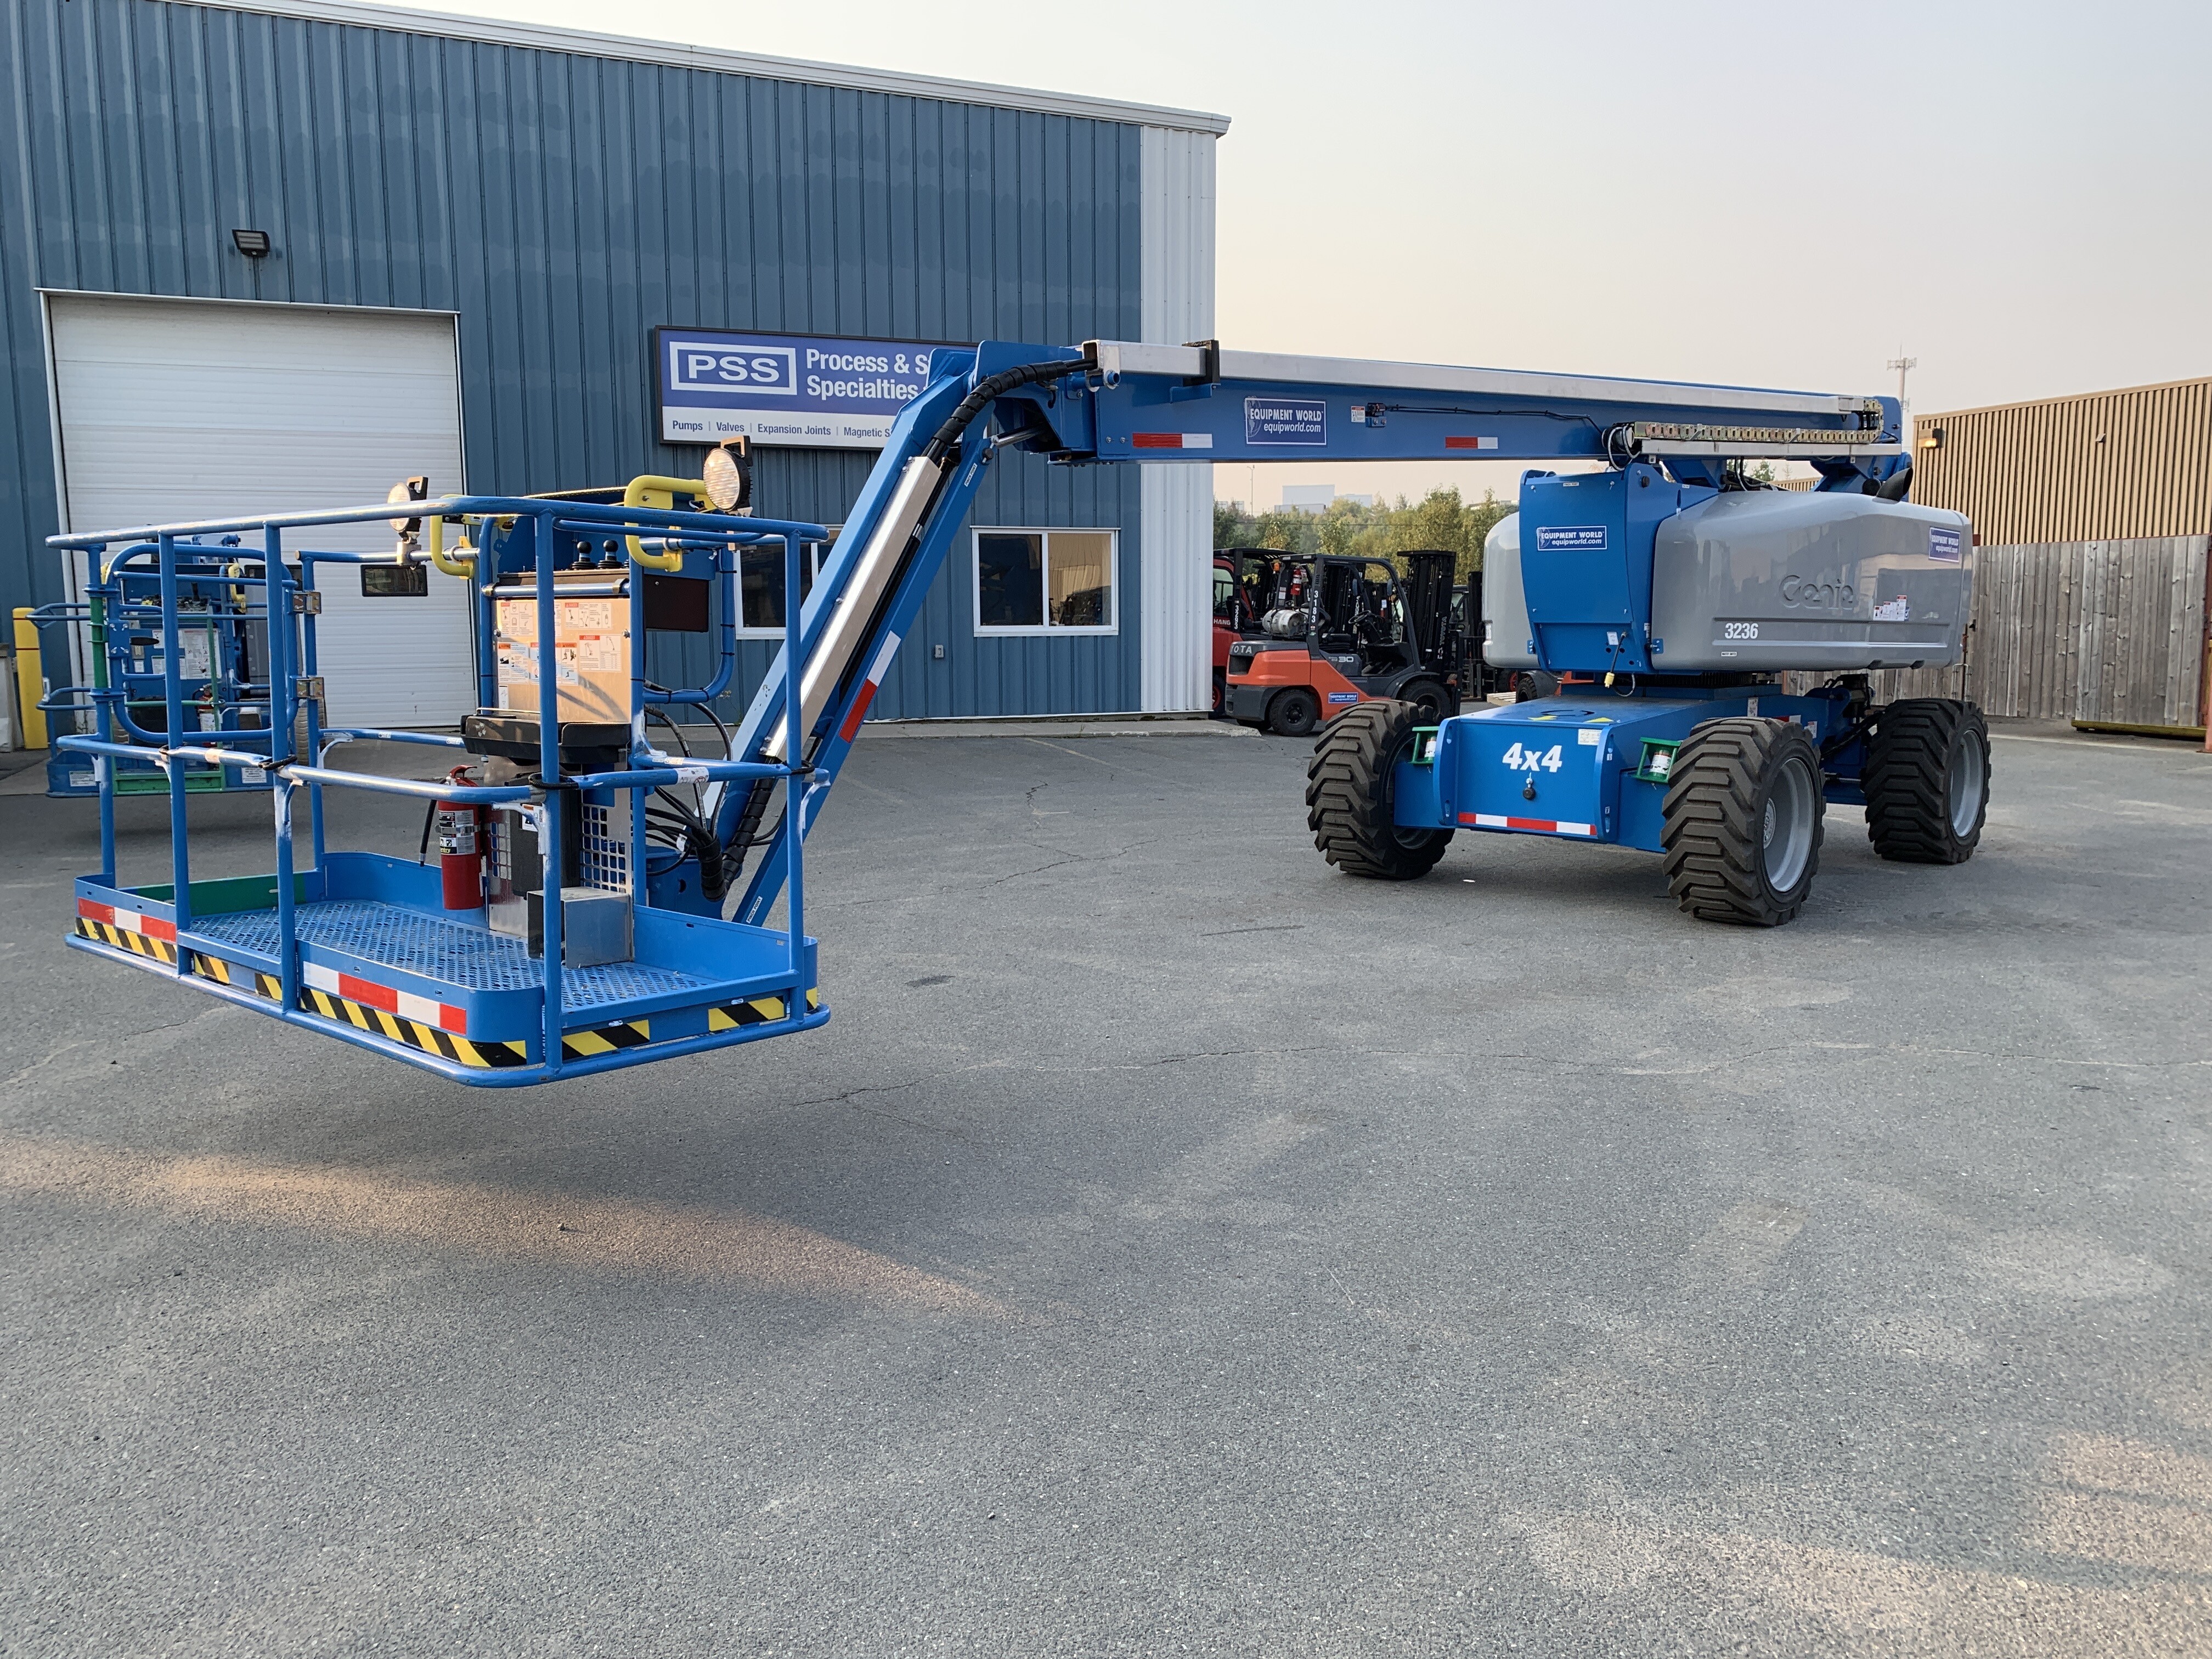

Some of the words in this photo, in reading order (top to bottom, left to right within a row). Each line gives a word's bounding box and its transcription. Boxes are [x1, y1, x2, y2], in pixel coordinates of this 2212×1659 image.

[687, 354, 780, 382] PSS
[806, 348, 888, 373] Process
[894, 353, 910, 374] &
[915, 354, 930, 375] S
[807, 375, 918, 400] Specialties
[1250, 408, 1293, 421] EQUIPMENT
[1296, 410, 1322, 421] WORLD
[672, 420, 703, 432] Pumps
[716, 422, 744, 432] Valves
[758, 424, 802, 436] Expansion
[805, 425, 831, 436] Joints
[844, 426, 882, 438] Magnetic
[882, 428, 891, 437] S
[1263, 421, 1322, 434] equipworld.com
[1779, 574, 1855, 610] Genie
[1439, 616, 1447, 646] TOYOTA
[1725, 623, 1759, 639] 3236
[1502, 742, 1562, 773] 4x4
[747, 910, 755, 922] PINCH
